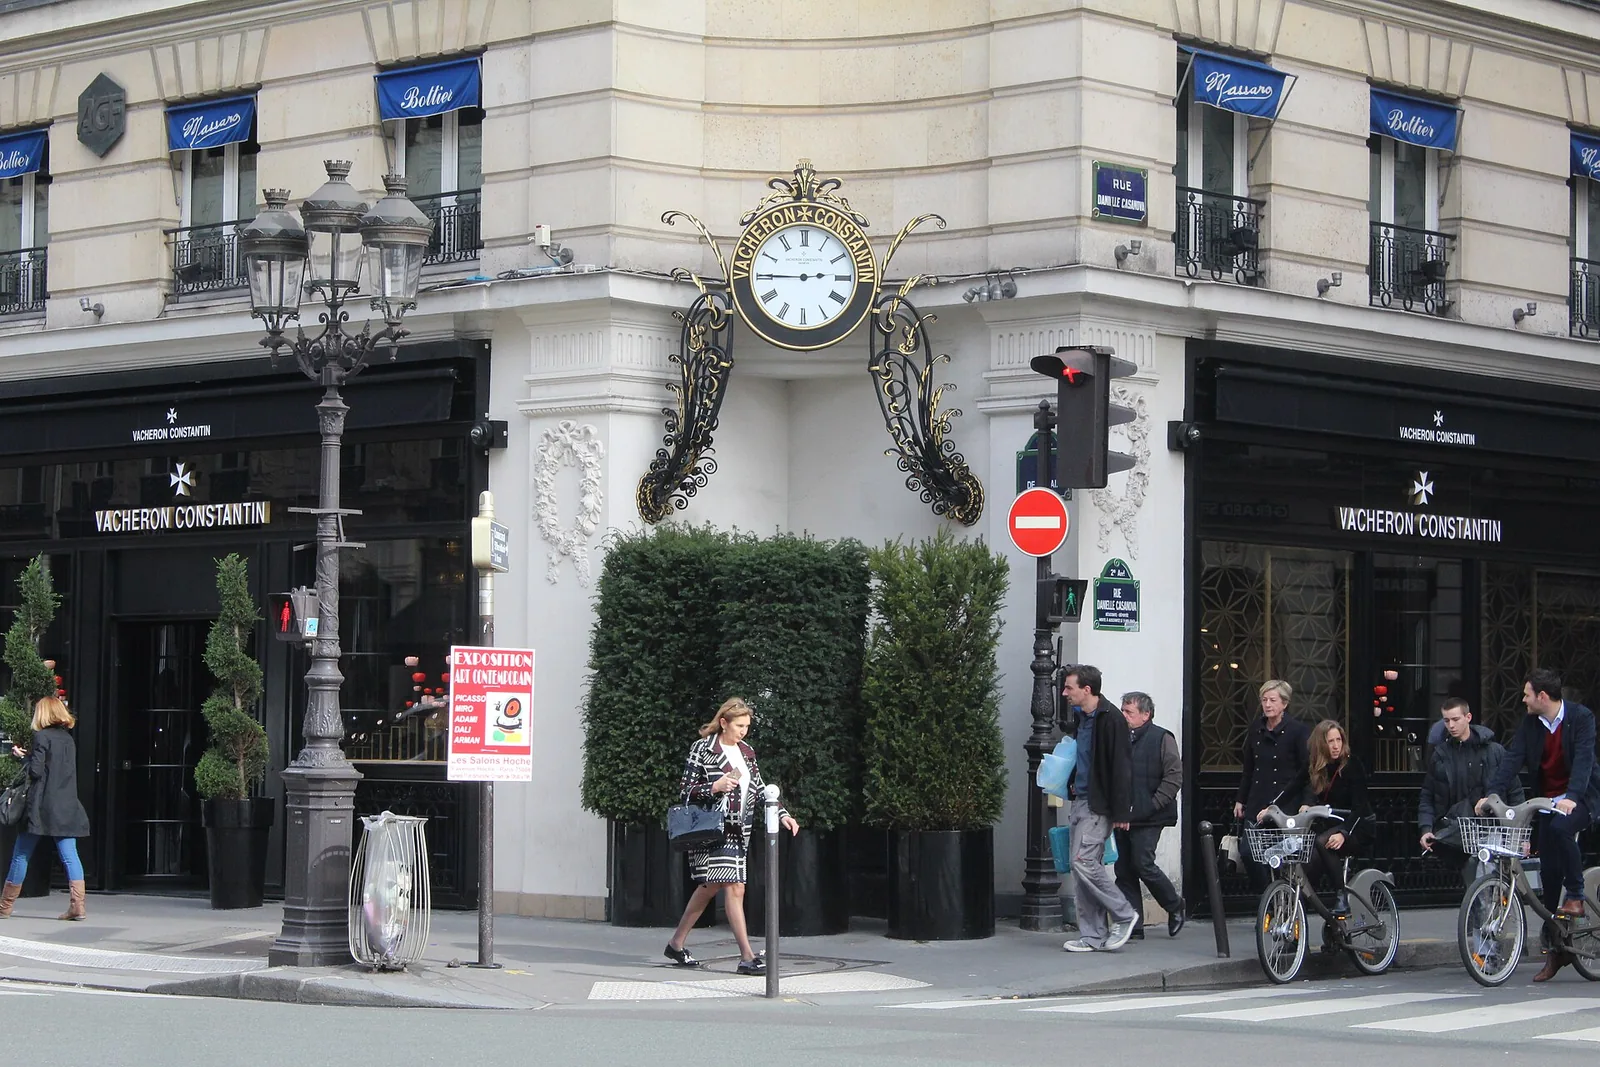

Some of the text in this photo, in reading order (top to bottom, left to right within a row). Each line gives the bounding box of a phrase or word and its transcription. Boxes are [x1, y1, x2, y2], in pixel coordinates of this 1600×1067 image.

[1205, 71, 1273, 103] Massaro
[400, 85, 453, 110] Bottier
[182, 112, 241, 148] Massaro
[1387, 108, 1434, 138] Bottier
[1113, 178, 1132, 192] RUE
[1121, 198, 1145, 212] CASANOVA
[733, 206, 874, 283] VACHERON CONSTANTIN
[132, 425, 211, 442] VACHERON CONSTANTIN
[1399, 426, 1476, 446] VACHERON CONSTANTIN
[95, 501, 267, 533] VACHERON CONSTANTIN
[1339, 506, 1502, 543] VACHERON CONSTANTIN
[1113, 587, 1122, 598] RUE
[1096, 599, 1137, 612] DANIELLE CASANOVA
[454, 651, 532, 667] EXPOSITION
[454, 668, 532, 686] ART CONTEMPORAIN
[455, 694, 487, 702] PICASSO
[454, 704, 474, 713] MIRO
[454, 715, 478, 723] ADAMI
[454, 726, 472, 734] DALI
[454, 736, 480, 744] ARMAN
[469, 756, 500, 765] Salons
[503, 757, 531, 765] Hoche
